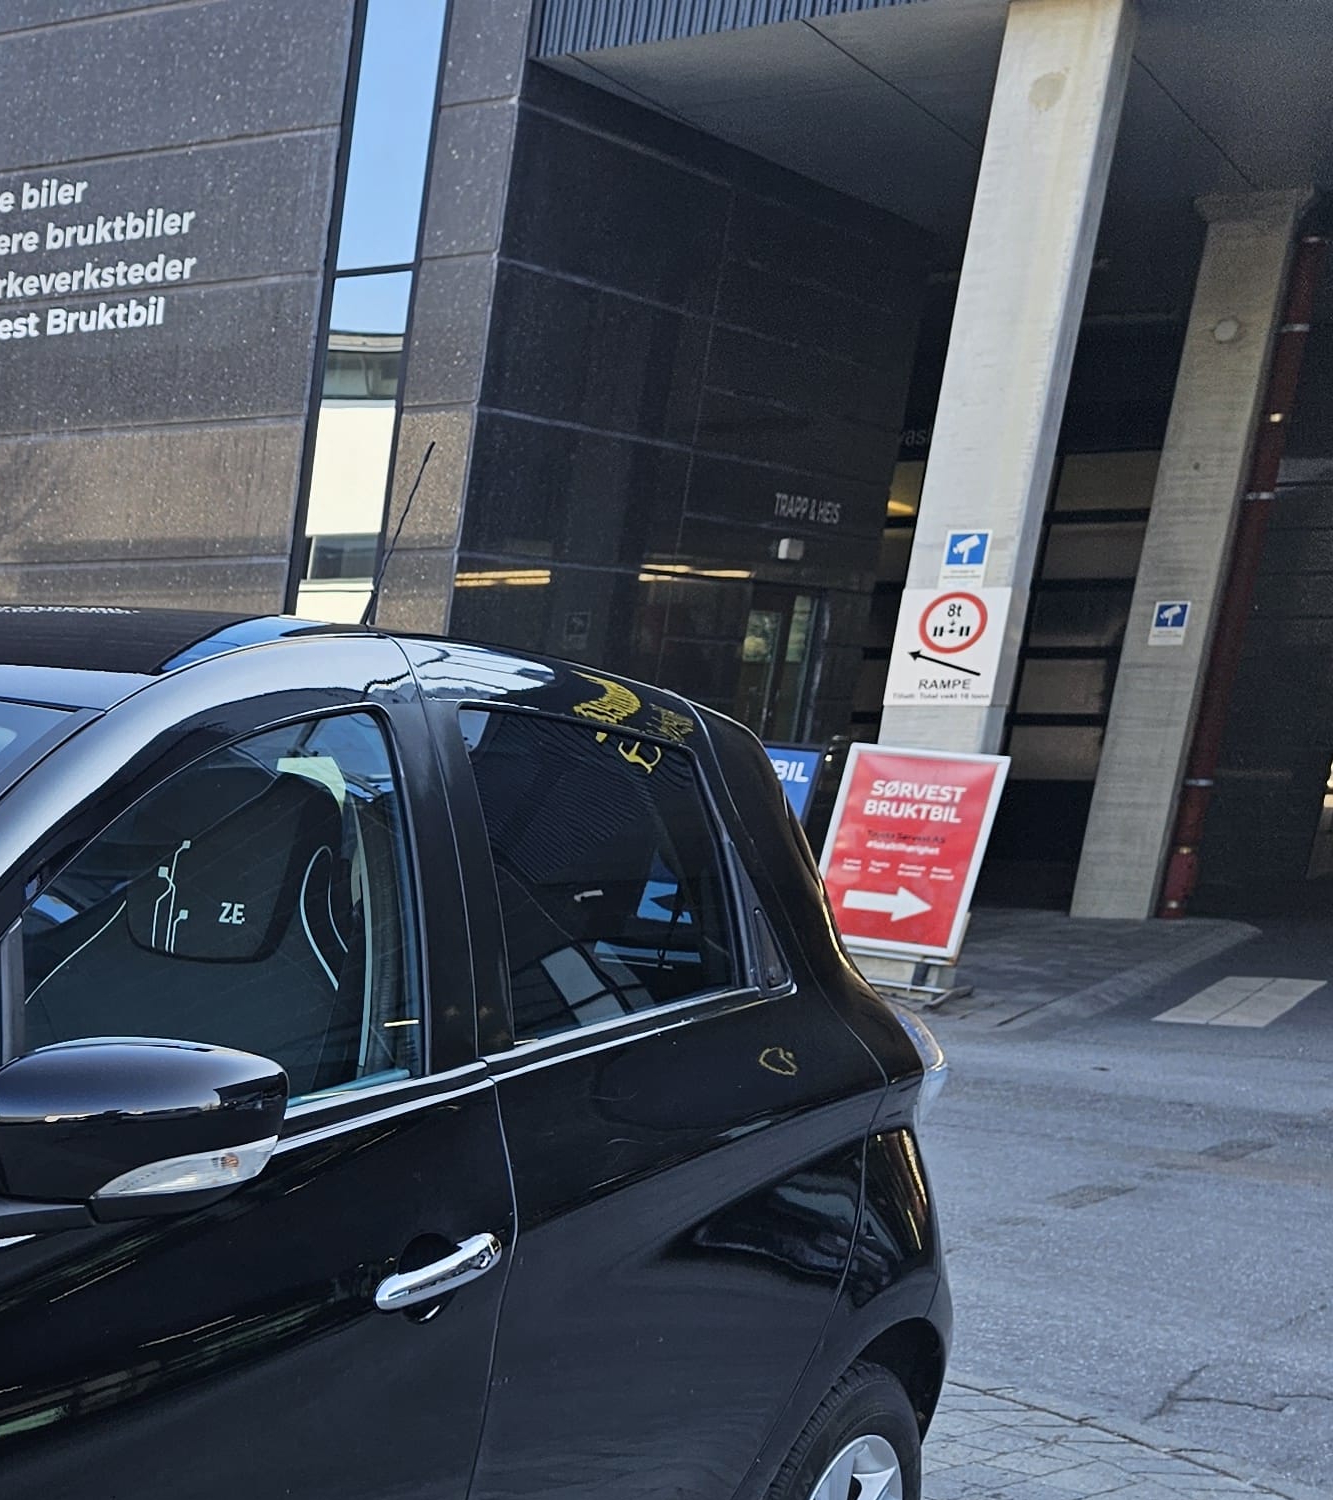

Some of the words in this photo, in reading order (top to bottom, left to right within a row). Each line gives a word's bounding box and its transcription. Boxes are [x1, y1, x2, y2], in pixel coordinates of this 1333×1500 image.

[21, 179, 88, 211] biler
[46, 208, 195, 250] bruktbiler
[46, 296, 165, 336] Bruktbil
[774, 492, 809, 520] TRAPP
[947, 604, 963, 618] 8t
[918, 679, 972, 690] RAMPE
[870, 779, 967, 803] SØRVEST
[863, 799, 962, 824] BRUKTBIL
